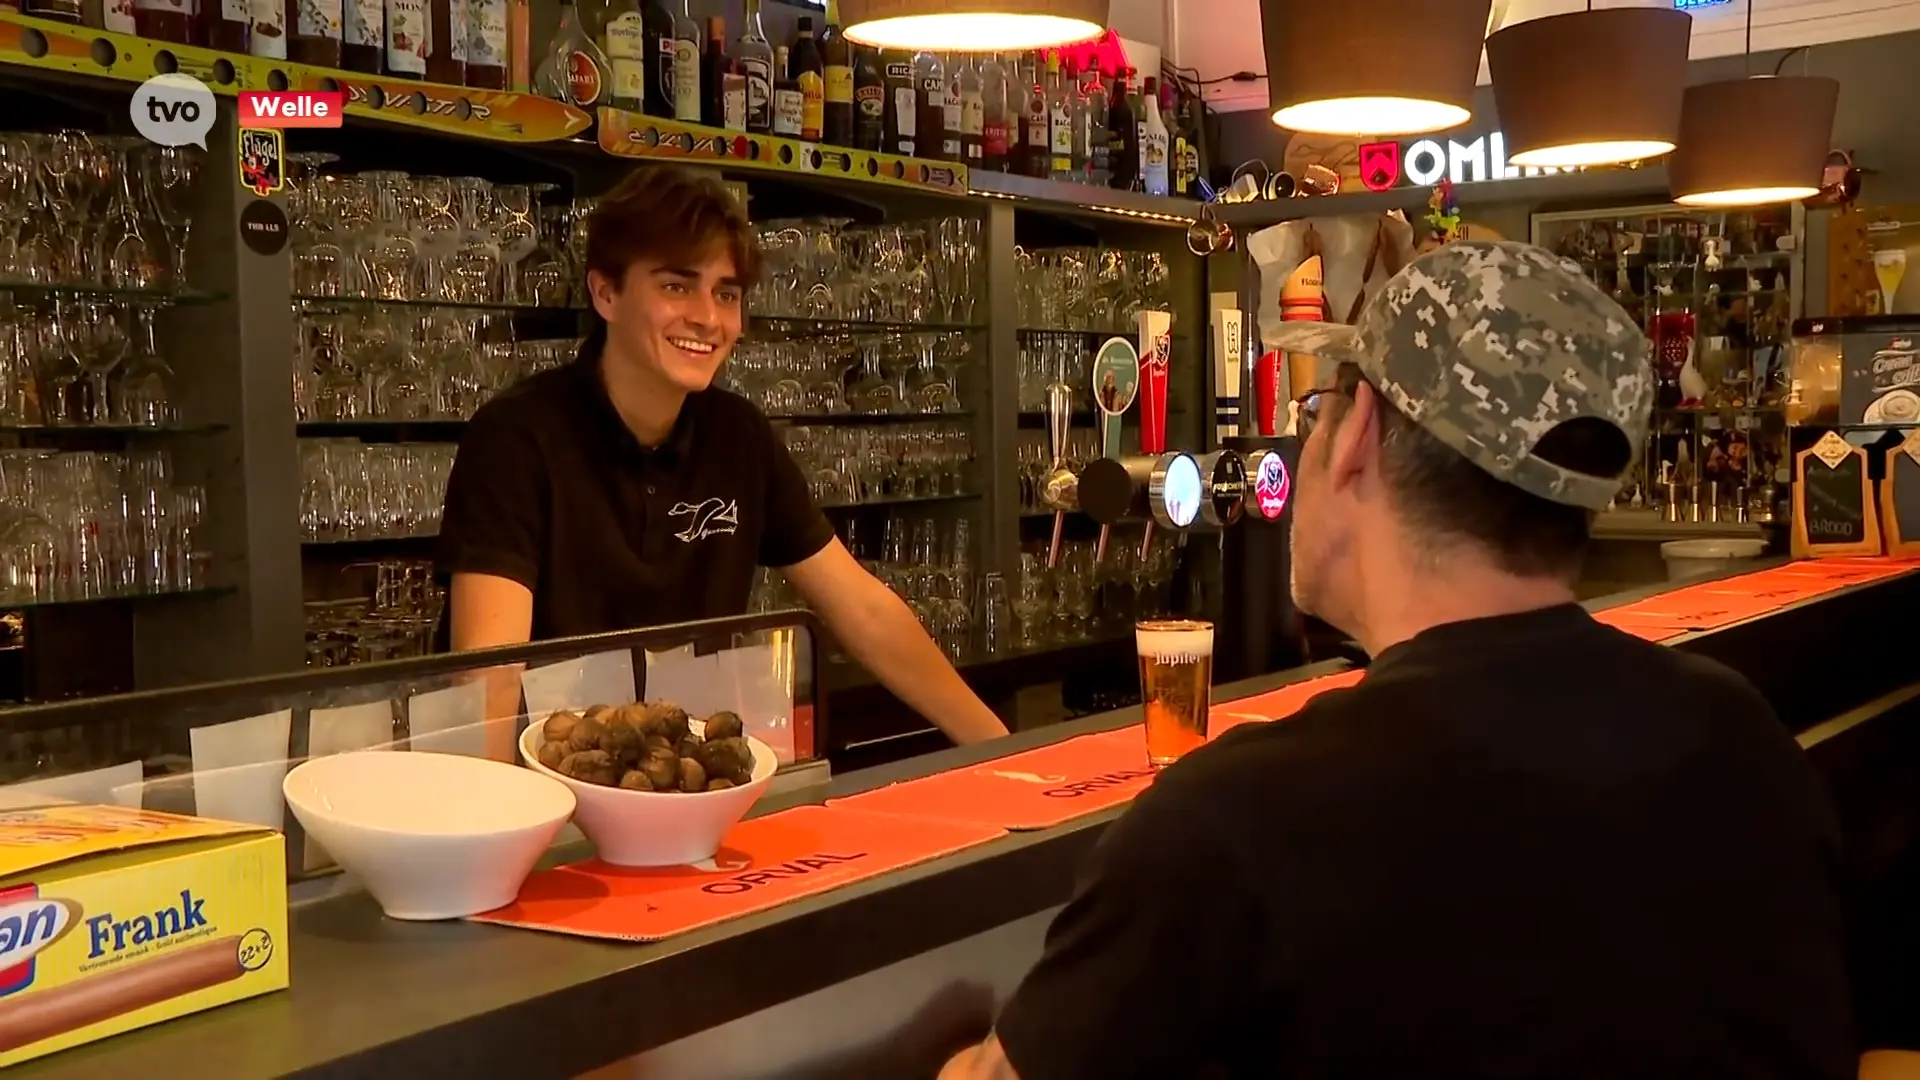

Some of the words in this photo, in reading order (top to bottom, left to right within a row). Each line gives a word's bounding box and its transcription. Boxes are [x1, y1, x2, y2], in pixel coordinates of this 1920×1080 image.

[1042, 771, 1155, 798] ORVAL
[701, 853, 868, 894] ORVAL
[86, 889, 208, 959] Frank
